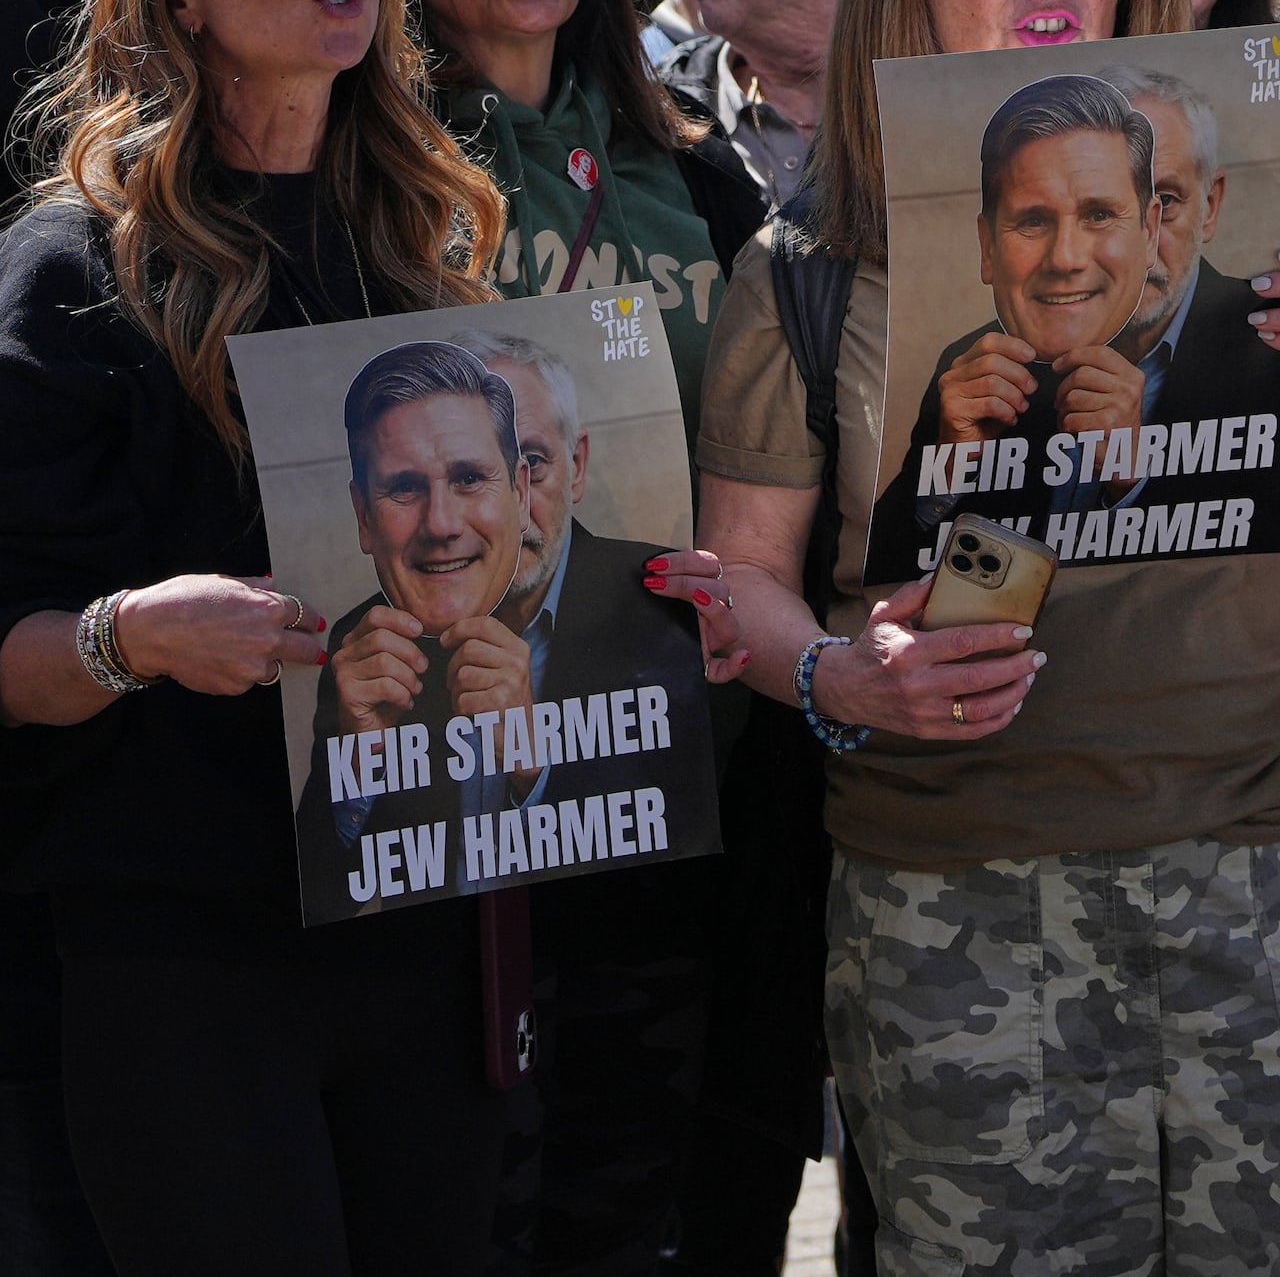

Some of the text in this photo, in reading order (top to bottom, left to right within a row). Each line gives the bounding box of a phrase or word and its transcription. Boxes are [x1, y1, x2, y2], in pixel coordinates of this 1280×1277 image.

[602, 317, 643, 340] THE
[602, 335, 651, 364] HATE
[916, 437, 1029, 497] KEIR
[1043, 413, 1278, 487] STARMER
[1045, 498, 1255, 561] HARMER
[326, 685, 671, 803] KEIR STARMER
[347, 786, 669, 904] JEW HARMER
